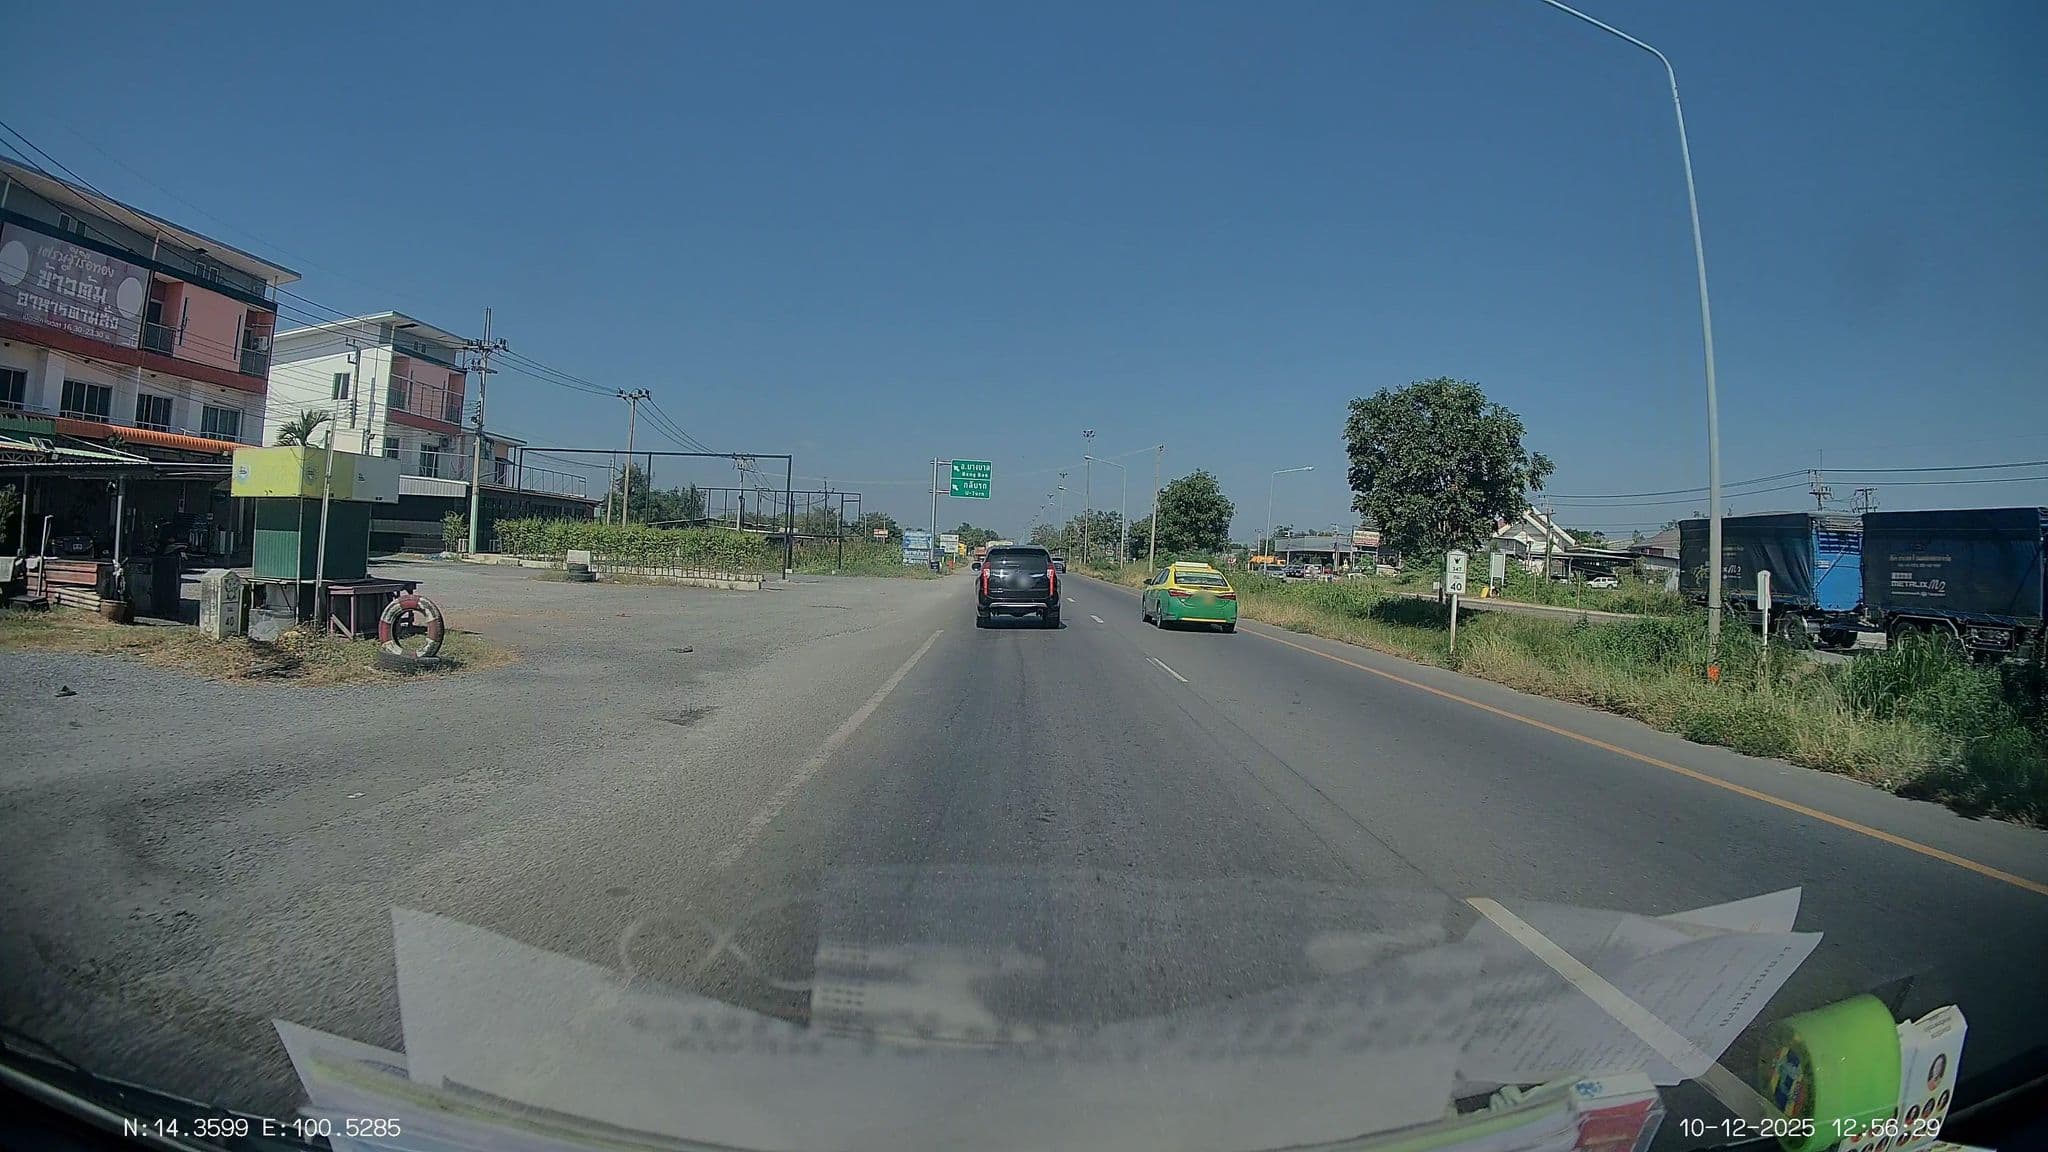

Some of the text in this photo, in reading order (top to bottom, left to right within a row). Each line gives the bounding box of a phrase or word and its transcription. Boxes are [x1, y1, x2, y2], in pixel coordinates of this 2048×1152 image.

[36, 261, 108, 304] ข้าวต้ม
[16, 291, 119, 330] อาหารตามสั่ง
[1450, 582, 1463, 591] 40
[225, 615, 235, 626] 40
